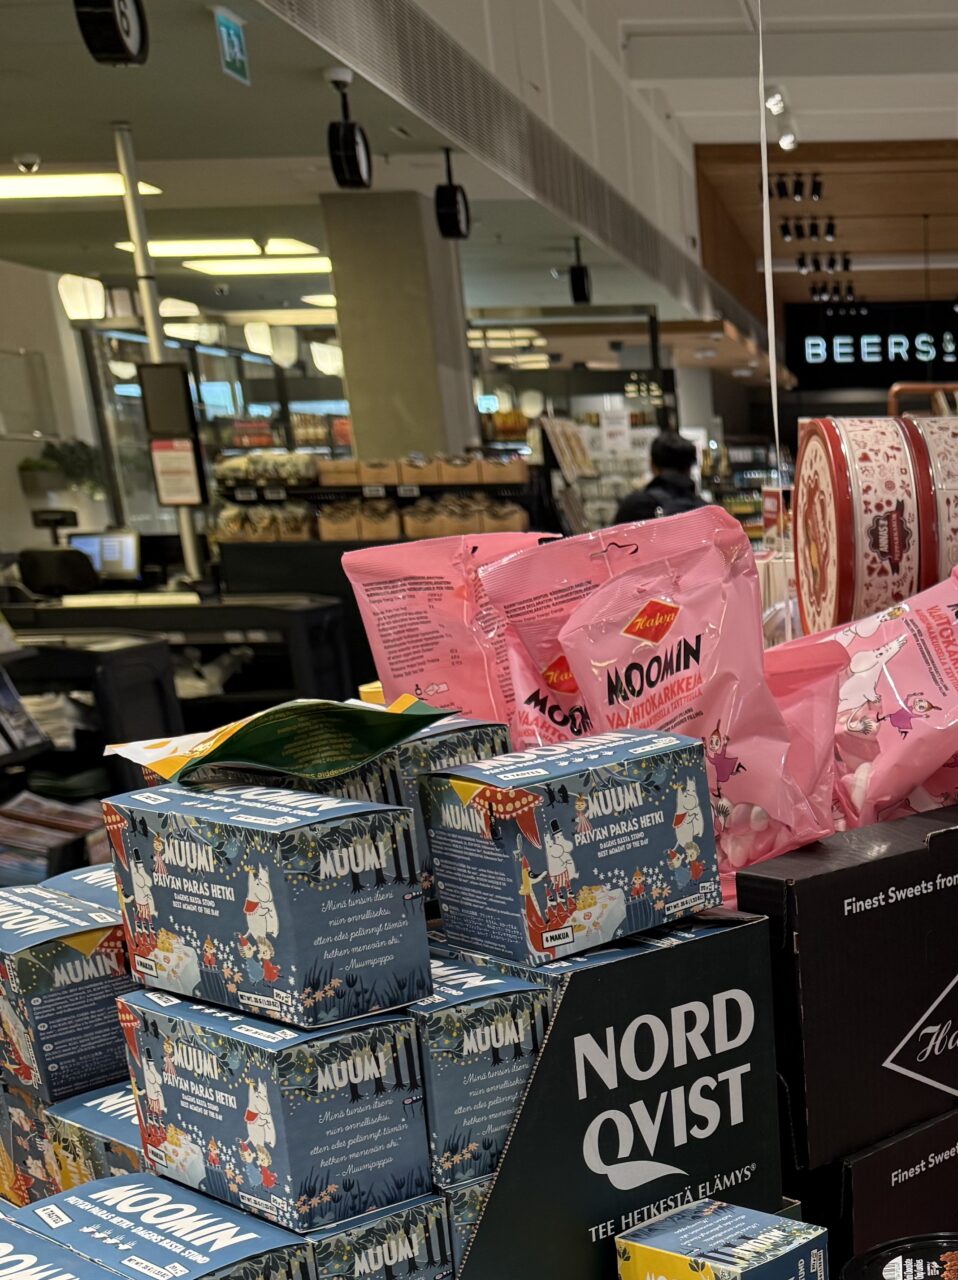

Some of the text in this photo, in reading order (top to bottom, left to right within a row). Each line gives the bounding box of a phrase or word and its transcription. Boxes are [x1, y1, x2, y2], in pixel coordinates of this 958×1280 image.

[804, 332, 937, 364] BEERS
[942, 331, 957, 363] &
[606, 633, 703, 706] MOOMIN
[440, 803, 488, 838] MUMIN
[586, 782, 644, 820] MUUMI
[609, 817, 639, 837] PARAS
[639, 810, 665, 829] HETKI
[161, 838, 216, 874] MUUMI
[319, 841, 388, 880] MUUMI
[182, 877, 210, 897] PARAS
[210, 883, 236, 902] HETKI
[843, 891, 886, 917] Finest
[888, 878, 934, 904] Sweets
[52, 952, 119, 988] MUMIN
[462, 1016, 525, 1057] MUUMI
[572, 987, 756, 1101] NORD
[172, 1041, 220, 1081] MUUMI
[316, 1050, 388, 1095] MUUMI
[581, 1062, 752, 1192] QVIST
[890, 1160, 927, 1188] Finest
[87, 1182, 263, 1253] MOOMIN
[588, 1219, 616, 1244] TEE
[620, 1185, 695, 1231] HETKESTÄ
[352, 1232, 420, 1279] MUUMI
